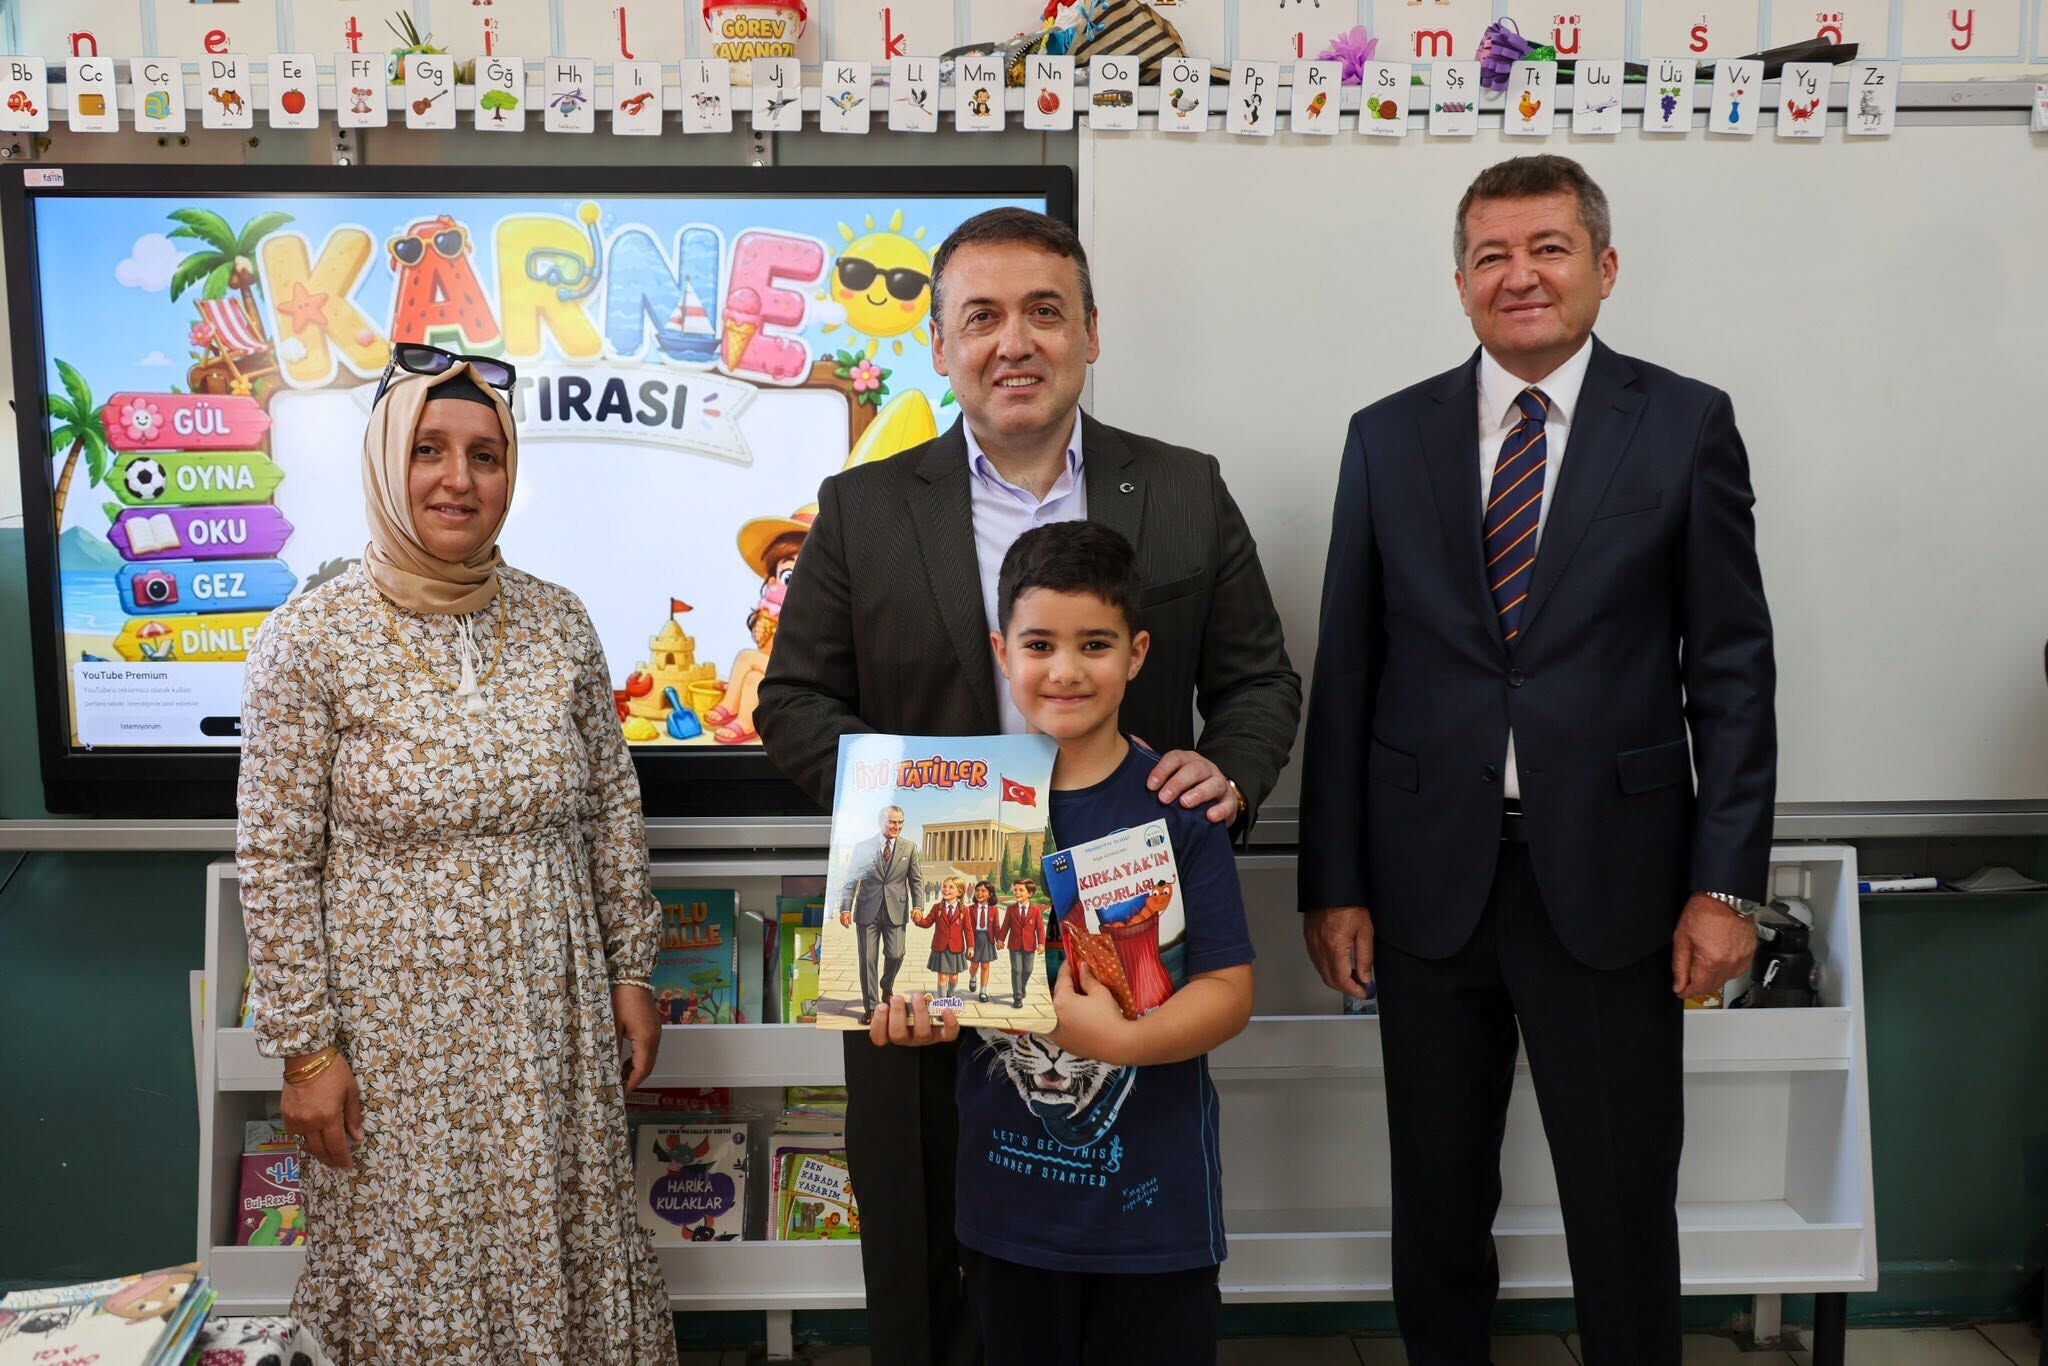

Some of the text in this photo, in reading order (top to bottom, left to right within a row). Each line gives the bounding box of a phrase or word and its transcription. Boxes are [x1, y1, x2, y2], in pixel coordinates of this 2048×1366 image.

[345, 16, 363, 54] t
[484, 18, 492, 56] i
[619, 7, 634, 59] l
[722, 14, 786, 39] GÖREV
[884, 7, 905, 60] k
[1555, 16, 1579, 55] ü
[1951, 9, 1973, 51] y
[72, 32, 98, 57] n
[204, 29, 229, 54] e
[1416, 30, 1453, 57] m
[1689, 25, 1709, 53] s
[11, 63, 33, 82] Bb
[79, 64, 103, 82] Cc
[144, 64, 170, 86] Çç
[211, 60, 236, 79] Dd
[282, 60, 302, 79] Ee
[351, 60, 370, 78] Ff
[416, 61, 443, 86] Gg
[487, 59, 513, 89] Ğğ
[557, 65, 582, 84] Hh
[701, 60, 709, 84] İi
[769, 64, 784, 89] Jj
[837, 67, 857, 84] Kk
[907, 64, 923, 82] Ll
[964, 64, 996, 82] Mm
[1037, 62, 1062, 80] Nn
[1101, 62, 1128, 80] Oo
[1173, 59, 1199, 83] Öö
[1245, 67, 1264, 93] Pp
[1308, 67, 1327, 86] Rr
[1378, 68, 1396, 87] Ss
[1446, 68, 1464, 89] Şş
[1525, 67, 1540, 86] Tt
[1587, 67, 1610, 85] Uu
[1660, 60, 1683, 83] Üü
[1728, 66, 1750, 85] Vv
[1863, 67, 1885, 86] Zz
[1796, 69, 1817, 95] Yy
[259, 215, 828, 384] KARNE
[514, 376, 688, 430] TIRASI
[173, 401, 231, 436] GÜL
[176, 465, 255, 492] OYNA
[188, 518, 248, 546] OKU
[192, 572, 247, 600] GEZ
[181, 622, 256, 655] DİNLE
[82, 671, 168, 680] YouTube Premium
[895, 755, 988, 789] TATİLLER
[1079, 850, 1170, 891] KIRKAYAK'IN
[662, 902, 709, 927] TLU
[659, 924, 723, 951] ALLE
[992, 1128, 1107, 1159] LET'S GET THIS
[804, 1160, 824, 1173] BEN
[1041, 1167, 1107, 1188] STARTED
[667, 1177, 714, 1193] HARİKA
[799, 1181, 841, 1200] YAŞARIM
[801, 1170, 839, 1188] KARADA
[656, 1196, 723, 1211] KULAKLAR
